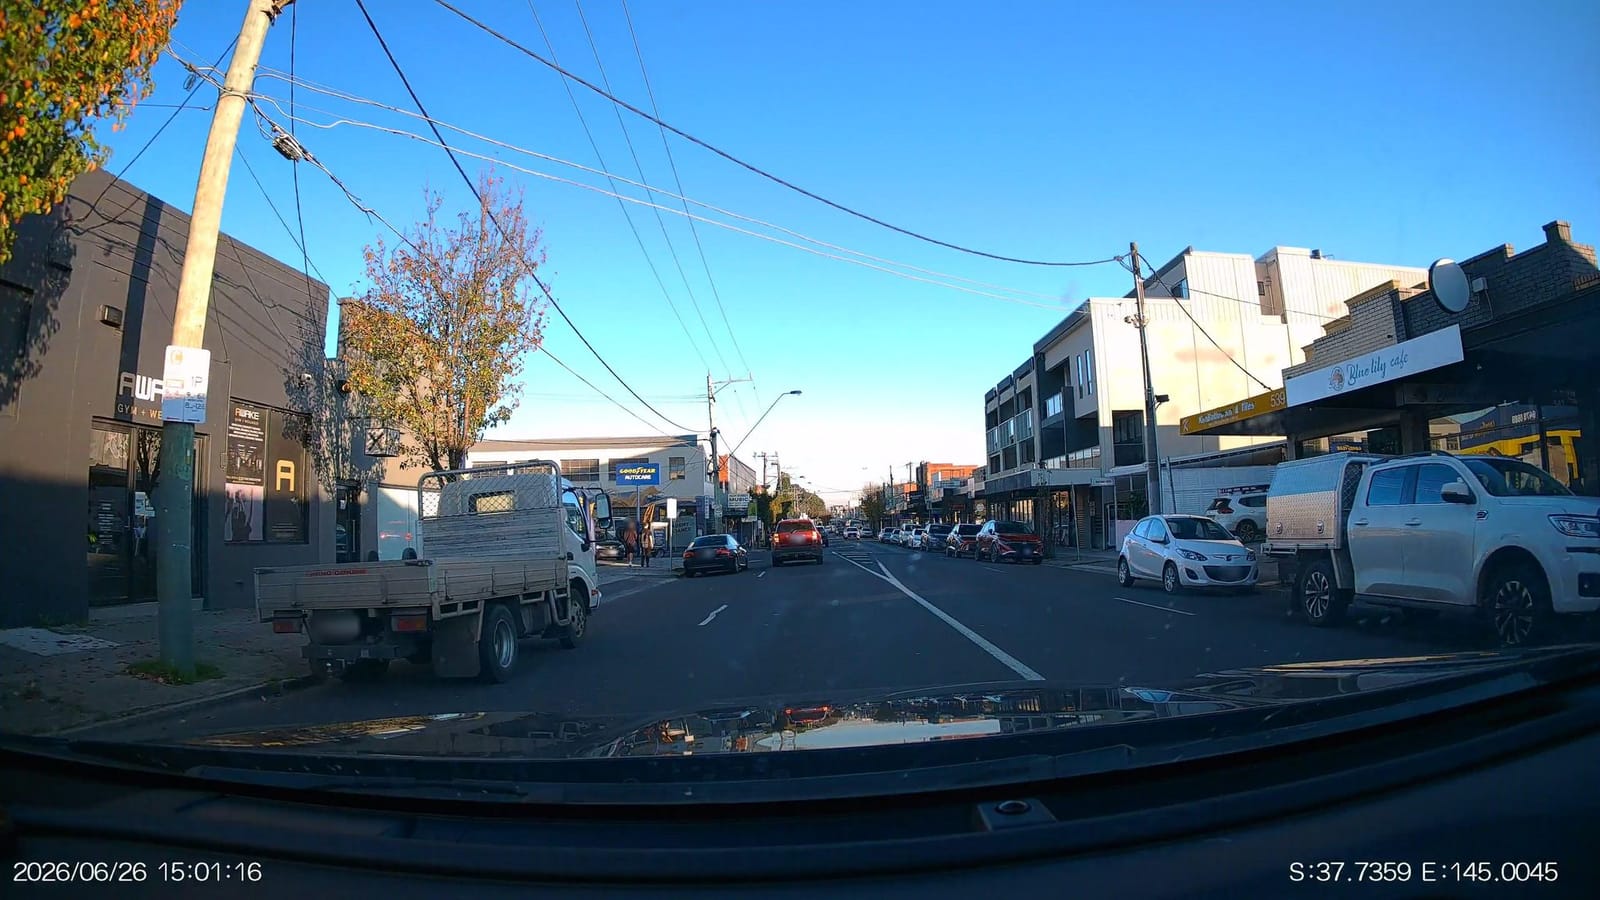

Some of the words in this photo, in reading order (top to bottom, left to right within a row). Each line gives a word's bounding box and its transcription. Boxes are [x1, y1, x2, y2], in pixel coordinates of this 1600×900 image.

[1371, 356, 1386, 378] lily
[119, 372, 163, 402] AWA
[1270, 391, 1286, 408] 539
[117, 403, 138, 416] GYM
[276, 460, 295, 491] A
[619, 466, 656, 475] GOODYEAR
